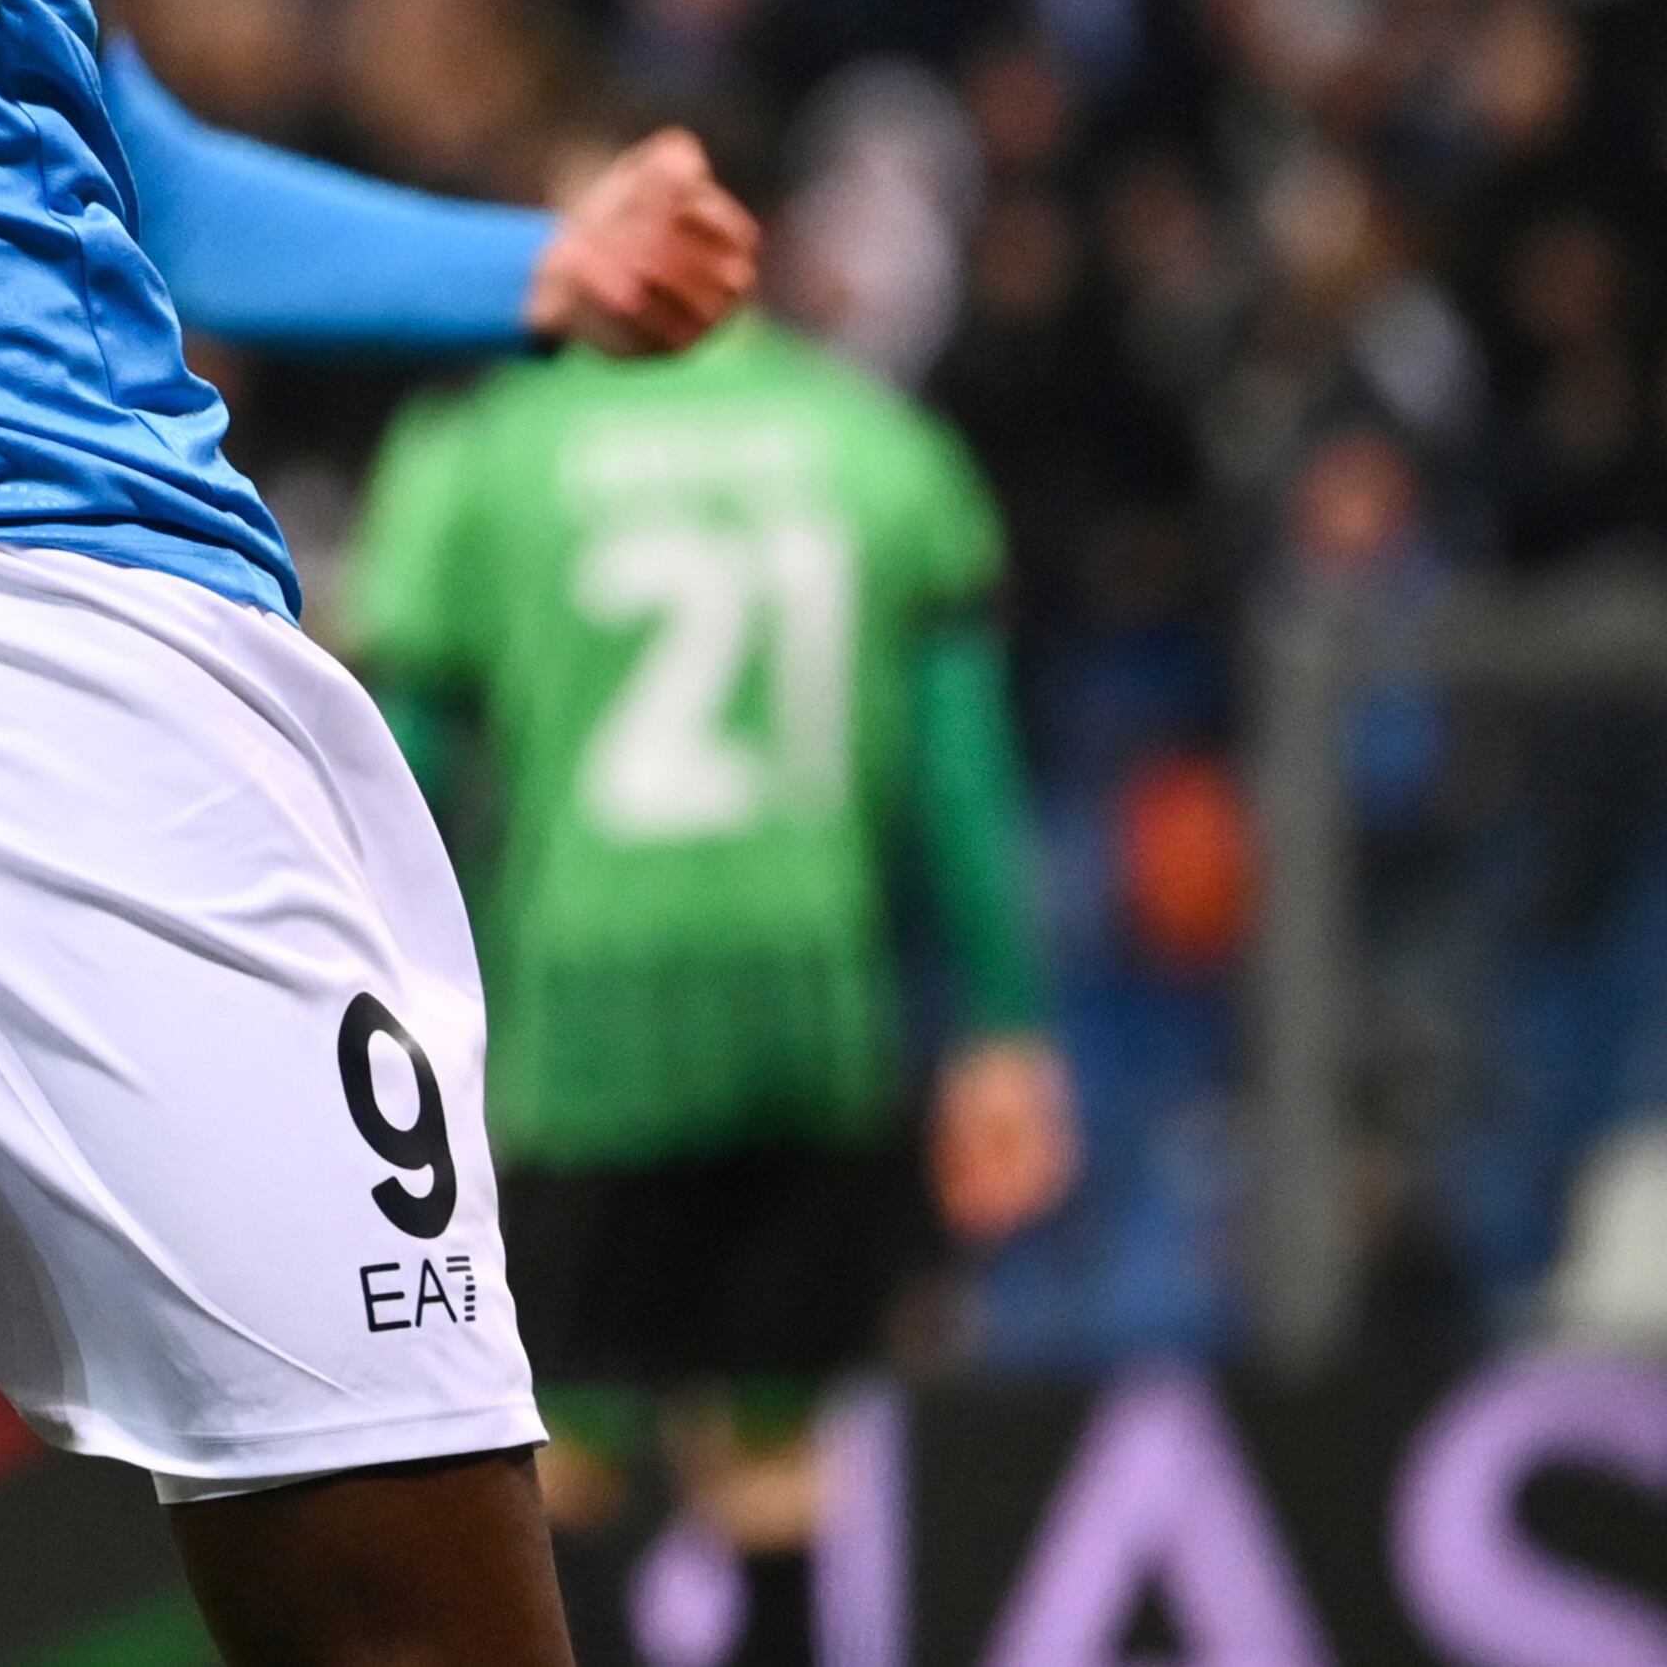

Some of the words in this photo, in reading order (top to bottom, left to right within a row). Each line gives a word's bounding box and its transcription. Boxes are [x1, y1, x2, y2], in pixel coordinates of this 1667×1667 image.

[572, 522, 857, 842] 21
[337, 991, 458, 1240] 9
[359, 1255, 477, 1333] EA7
